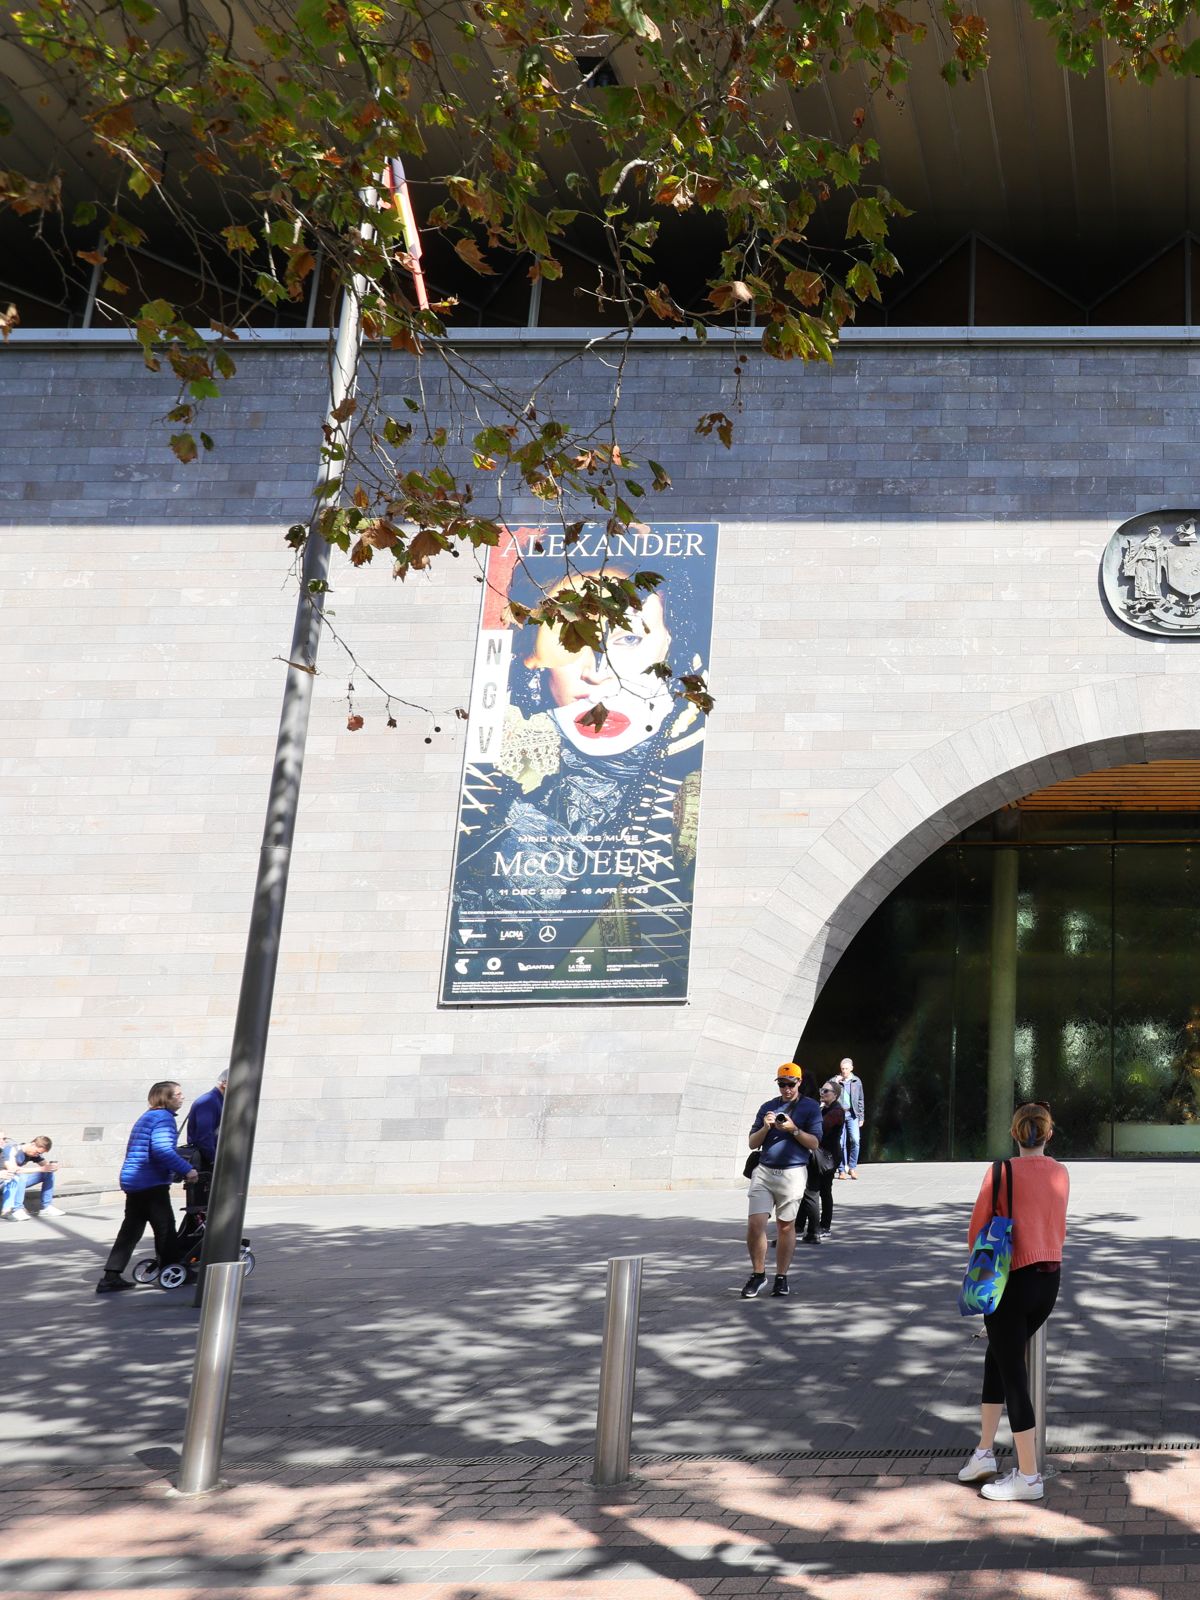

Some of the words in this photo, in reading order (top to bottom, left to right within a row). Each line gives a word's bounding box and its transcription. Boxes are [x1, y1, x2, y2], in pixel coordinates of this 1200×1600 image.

[502, 532, 706, 558] ALEXANDER
[518, 835, 548, 843] MIND
[551, 834, 602, 843] MYTHOS
[605, 834, 639, 842] MUSE
[491, 849, 661, 881] McQUEEN
[498, 888, 509, 896] 11
[512, 888, 538, 896] DEC
[595, 887, 618, 895] APR
